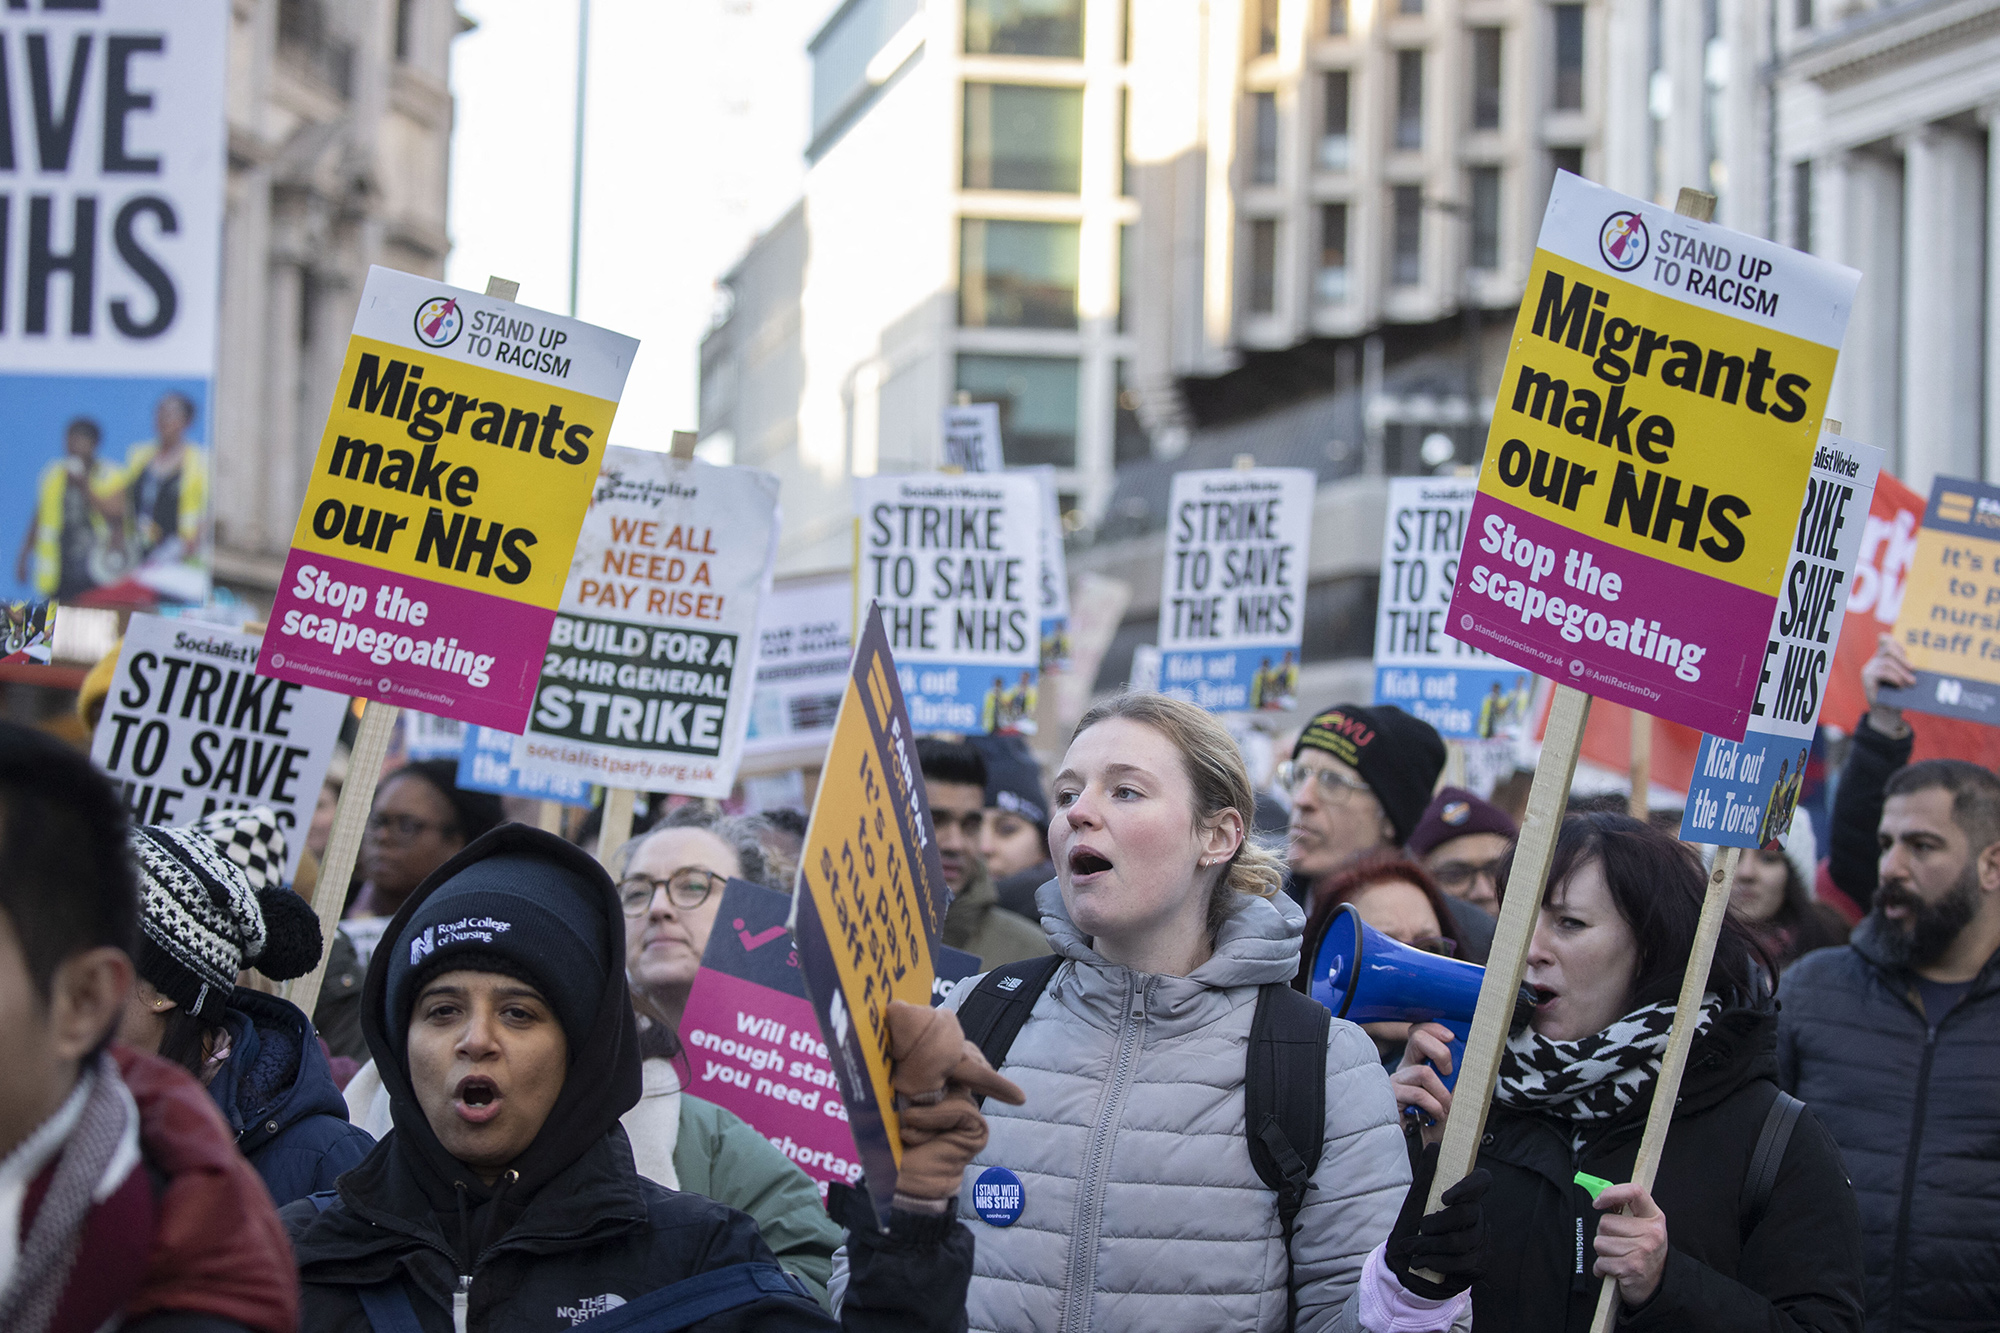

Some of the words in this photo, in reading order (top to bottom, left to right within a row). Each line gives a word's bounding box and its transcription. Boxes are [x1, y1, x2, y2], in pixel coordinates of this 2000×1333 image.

[0, 32, 165, 174] VE
[1657, 229, 1731, 272] STAND
[1738, 254, 1772, 283] UP
[1653, 256, 1681, 286] TO
[1686, 269, 1779, 317] RACISM
[471, 309, 534, 343] STAND
[539, 327, 568, 351] UP
[1531, 269, 1812, 423] Migrants
[467, 332, 493, 358] TO
[495, 343, 571, 378] RACISM
[347, 352, 594, 465] Migrants
[1511, 364, 1675, 464] make
[327, 442, 479, 507] make
[1833, 450, 1860, 479] Worker
[1177, 498, 1281, 544] STRIKE
[1498, 438, 1598, 512] our
[1604, 460, 1751, 563] NHS
[312, 498, 409, 554] our
[414, 506, 538, 585] NHS
[610, 515, 660, 548] WE
[665, 525, 717, 556] ALL
[872, 504, 1004, 550] STRIKE
[602, 549, 685, 583] NEED
[692, 562, 712, 587] A
[870, 555, 915, 599] TO
[933, 556, 1022, 601] SAVE
[1175, 550, 1212, 591] TO
[1222, 546, 1293, 590] SAVE
[1391, 559, 1428, 604] TO
[1479, 514, 1555, 583] Stop
[1564, 548, 1623, 601] the
[1942, 546, 1984, 572] It's
[292, 564, 368, 619] Stop
[375, 584, 428, 626] the
[578, 579, 639, 610] PAY
[647, 588, 726, 621] RISE!
[1779, 560, 1845, 644] SAVE
[1949, 577, 1978, 598] to
[954, 608, 1026, 652] NHS
[1172, 597, 1222, 641] THE
[1235, 593, 1293, 635] NHS
[1387, 611, 1441, 655] THE
[1469, 565, 1706, 682] scapegoating
[174, 631, 249, 663] Socialist
[281, 609, 495, 688] scapegoating
[550, 616, 648, 657] BUILD
[651, 631, 710, 667] FOR
[711, 637, 736, 668] A
[1474, 623, 1564, 668] standuptoracism.org.uk
[1584, 667, 1661, 701] @AntiRacismDay
[1906, 628, 1973, 655] staff
[120, 652, 303, 738] STRIKE
[285, 659, 373, 687] standuptoracism.org.uk
[392, 682, 455, 707] @AntiRacismDay
[541, 653, 617, 687] 24HR
[616, 664, 729, 699] GENERAL
[1772, 644, 1827, 725] NHS
[535, 684, 725, 750] STRIKE
[106, 713, 170, 777] TO
[182, 729, 309, 804] SAVE
[526, 742, 718, 782] socialistparty.org.uk
[1703, 737, 1740, 781] Kick
[1739, 747, 1766, 785] out
[890, 716, 914, 793] FAIR
[910, 789, 928, 850] PAY
[886, 736, 907, 801] FOR
[904, 800, 939, 936] NURSING
[1692, 789, 1718, 831] the
[1719, 792, 1761, 835] Tories
[858, 749, 887, 842] It's
[886, 842, 919, 970] time
[819, 846, 865, 972] staff
[857, 815, 876, 879] to
[875, 884, 906, 982] pay
[437, 935, 449, 946] of
[449, 930, 493, 943] Nursing
[438, 917, 467, 934] Royal
[468, 917, 511, 933] College
[841, 836, 893, 1010] nursin
[689, 1028, 785, 1073] enough
[736, 1011, 787, 1046] Will
[701, 1060, 752, 1090] you
[755, 1077, 821, 1112] need
[976, 1196, 993, 1209] NHS
[994, 1197, 1019, 1209] STAFF
[979, 1184, 1000, 1196] STAND
[1001, 1184, 1020, 1196] WITH
[557, 1305, 606, 1320] NORTH
[579, 1294, 606, 1309] THE
